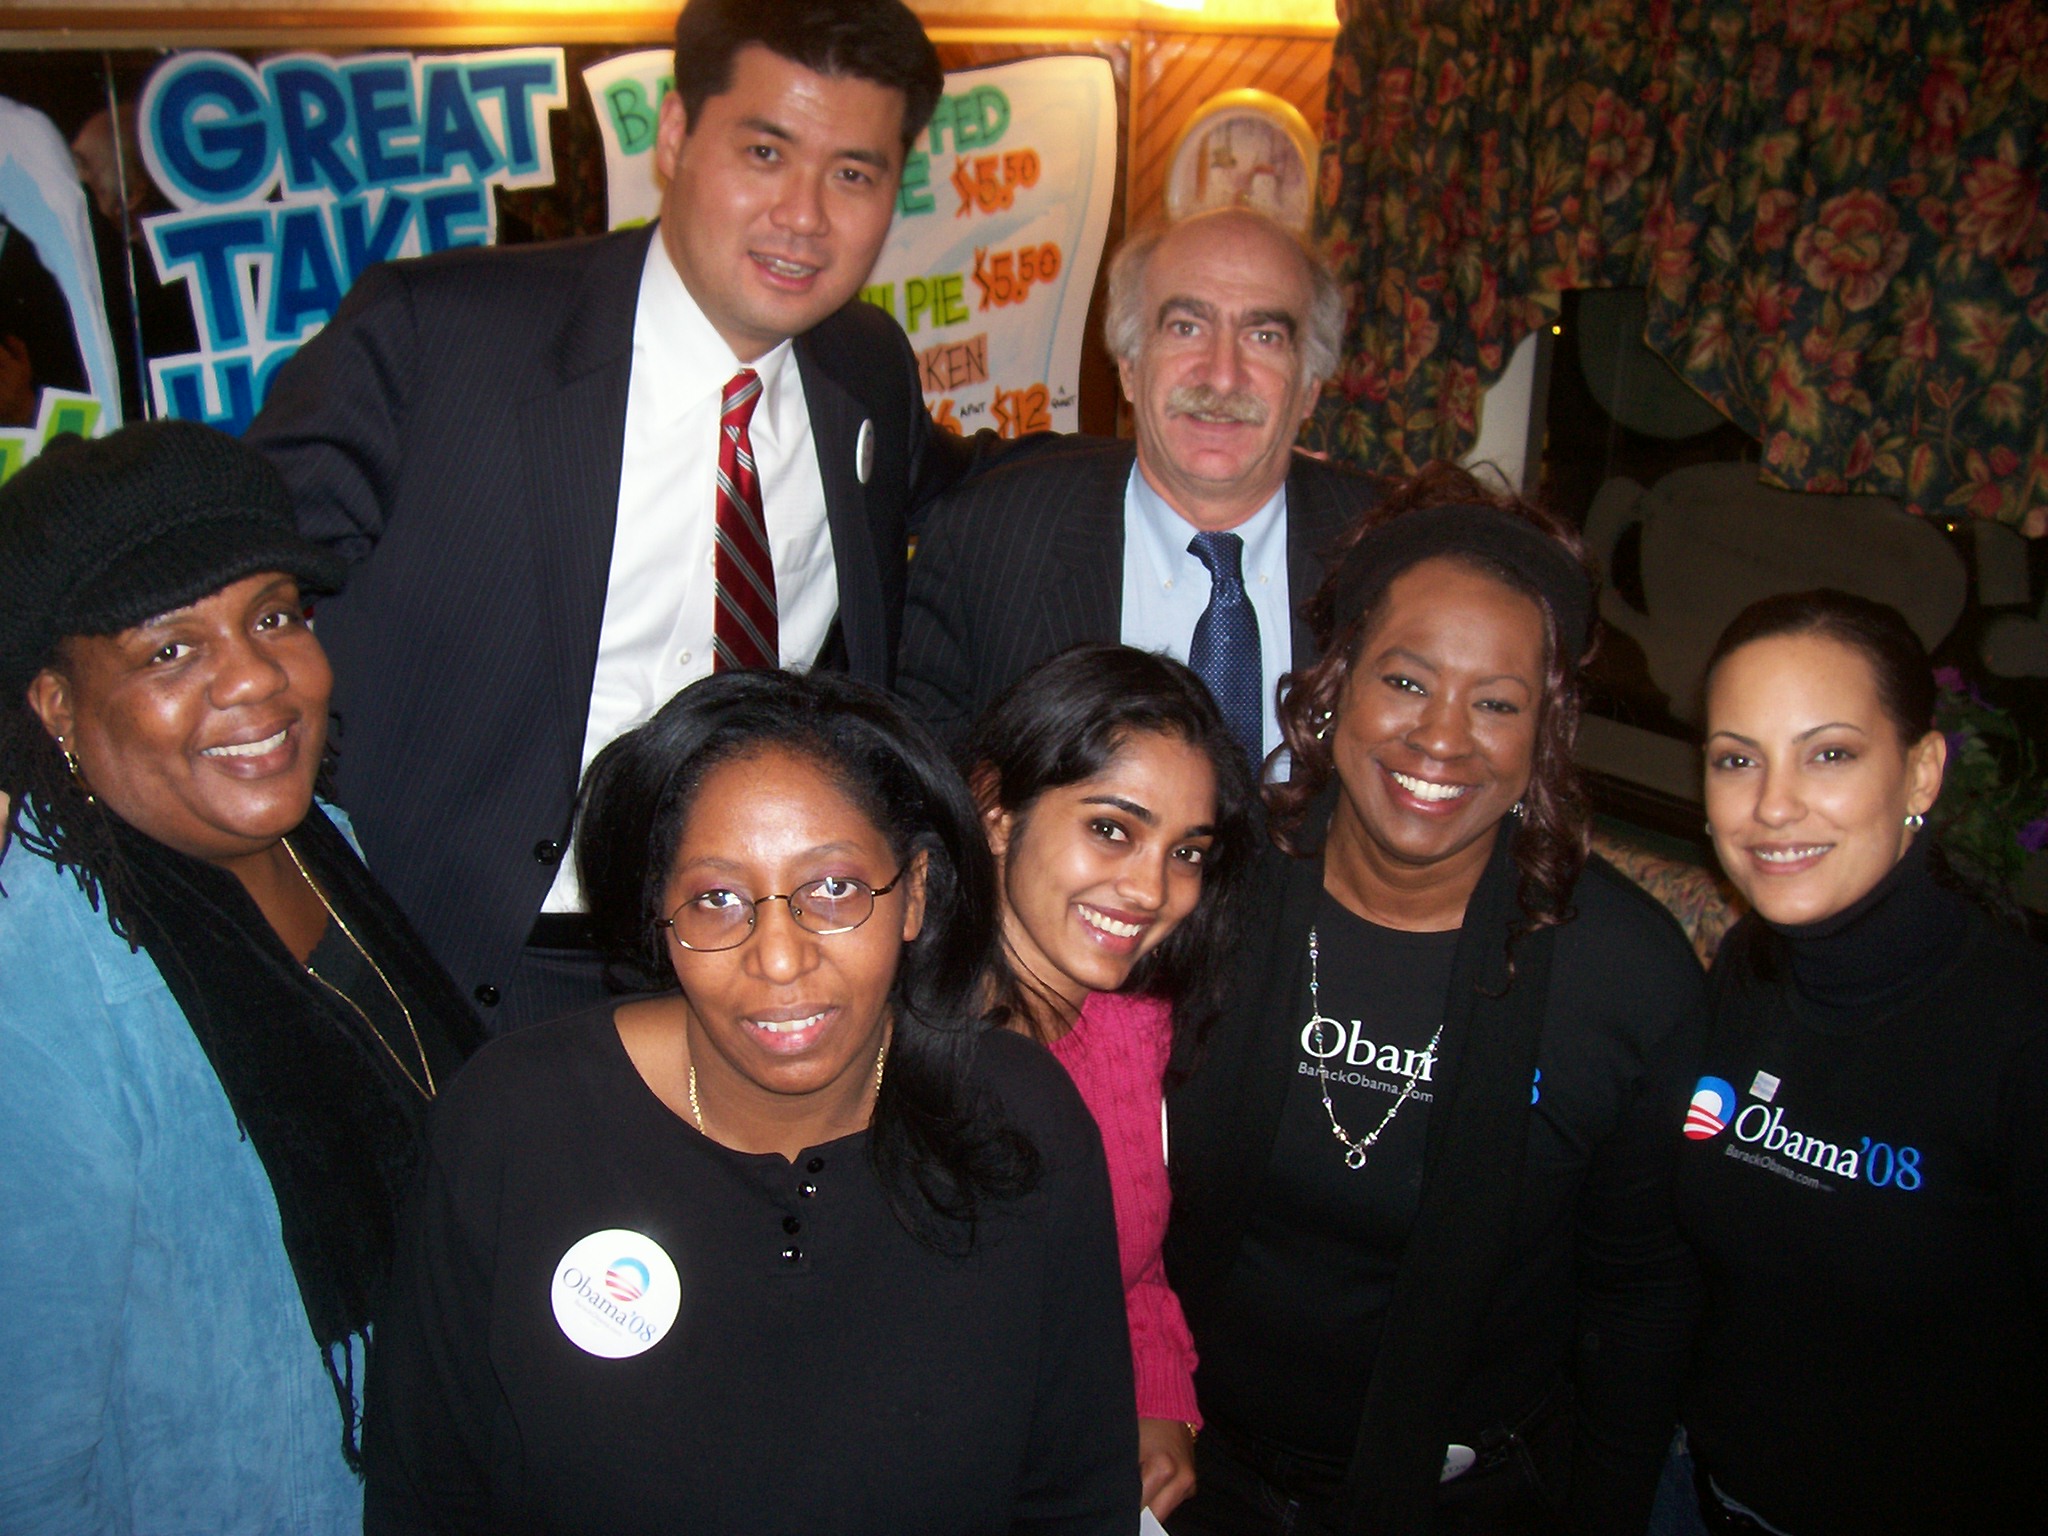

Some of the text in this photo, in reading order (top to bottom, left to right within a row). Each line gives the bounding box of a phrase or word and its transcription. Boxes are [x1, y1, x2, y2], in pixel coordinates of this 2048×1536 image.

[148, 56, 562, 206] GREAT
[150, 186, 492, 356] TAKE
[905, 272, 970, 334] PIE
[971, 242, 1062, 313] $5.50
[918, 332, 990, 392] KEN
